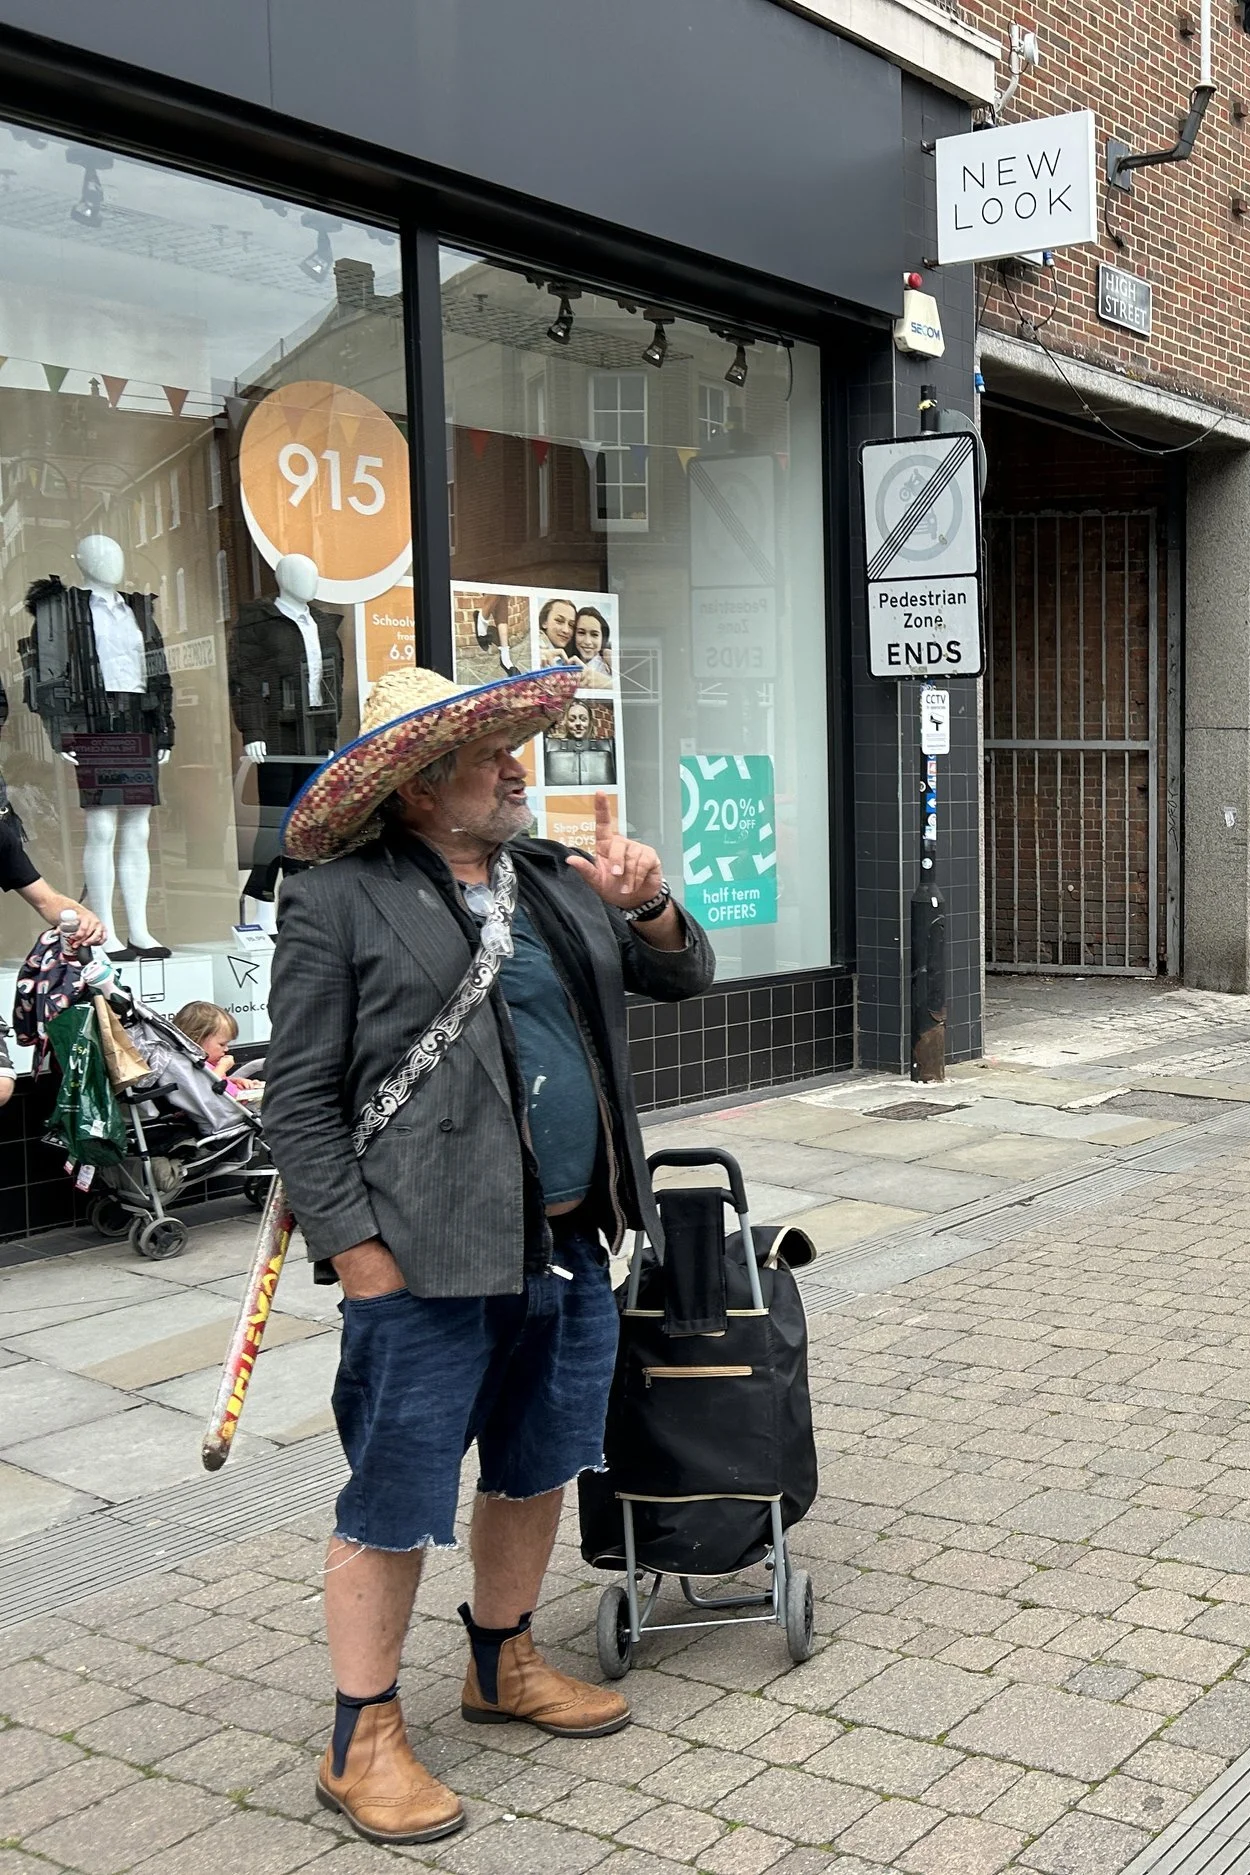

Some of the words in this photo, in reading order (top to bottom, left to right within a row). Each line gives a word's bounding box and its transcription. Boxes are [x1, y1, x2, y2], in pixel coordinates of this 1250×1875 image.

[963, 148, 1062, 192] NEW
[954, 184, 1072, 231] LOOK
[1105, 272, 1136, 301] HIGH
[1105, 295, 1147, 328] STREET
[910, 321, 941, 342] SECOM
[278, 443, 386, 516] 915
[879, 589, 967, 609] Pedestrian
[903, 612, 943, 629] Zone
[887, 640, 962, 666] ENDS
[926, 694, 946, 704] CCTV
[703, 798, 756, 831] 20%
[739, 820, 756, 830] OFF
[553, 823, 578, 835] Shop
[703, 887, 729, 904] half
[731, 888, 760, 902] term
[708, 904, 757, 922] OFFERS
